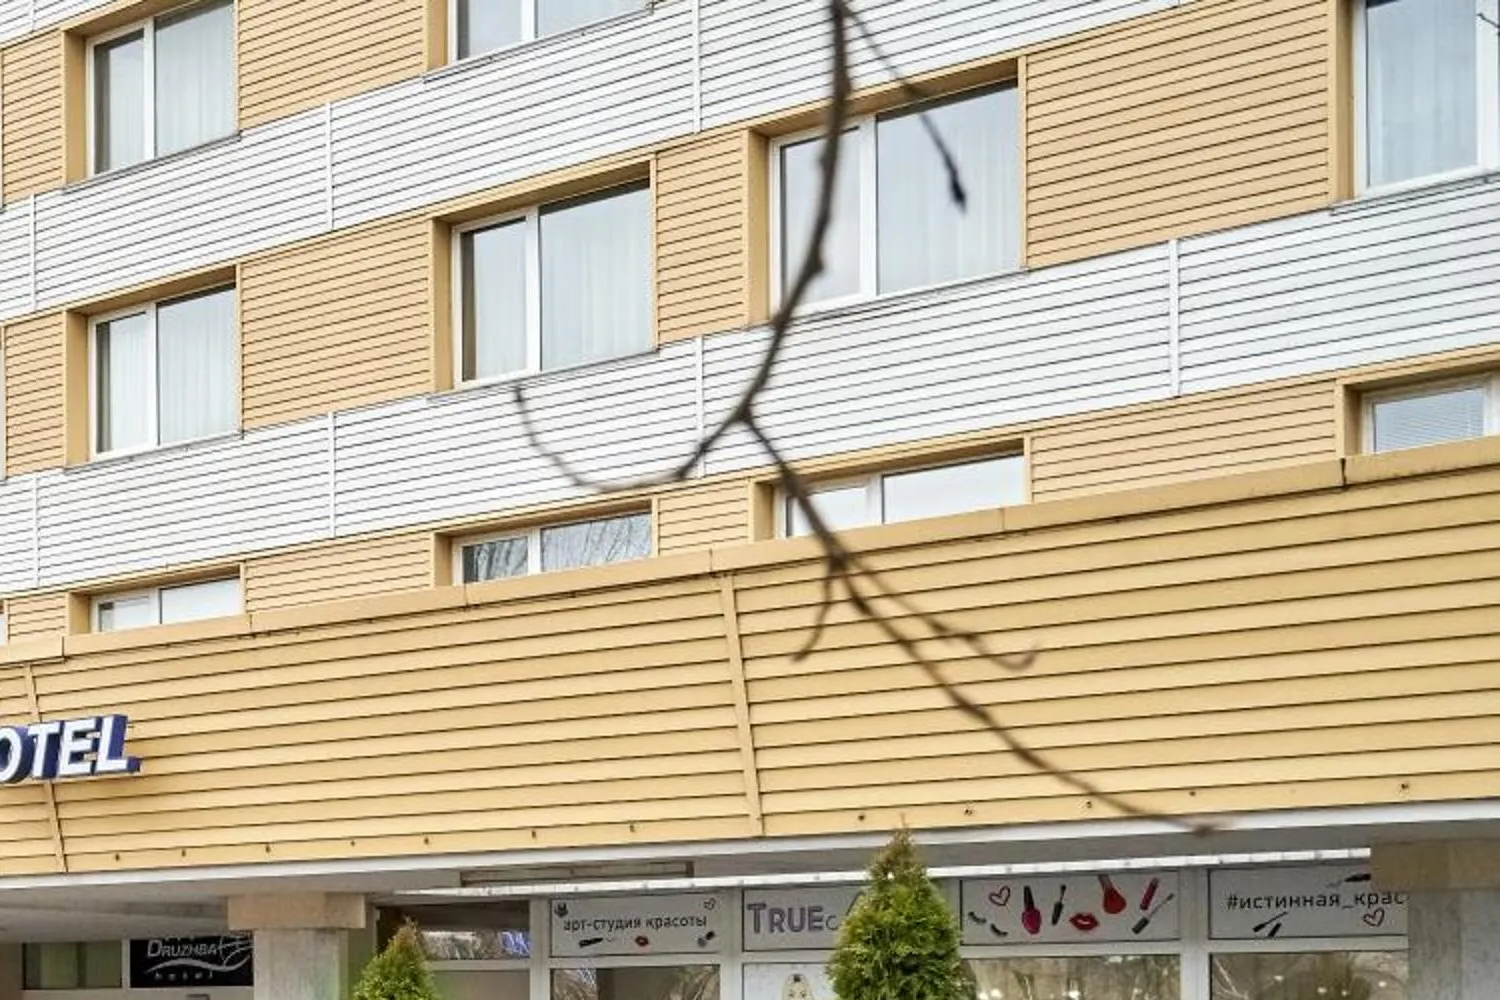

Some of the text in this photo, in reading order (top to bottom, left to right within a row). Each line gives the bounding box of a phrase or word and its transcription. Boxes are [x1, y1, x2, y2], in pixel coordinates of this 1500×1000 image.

[1227, 889, 1409, 910] #истинная_крас
[563, 914, 707, 933] арт-студия красоты
